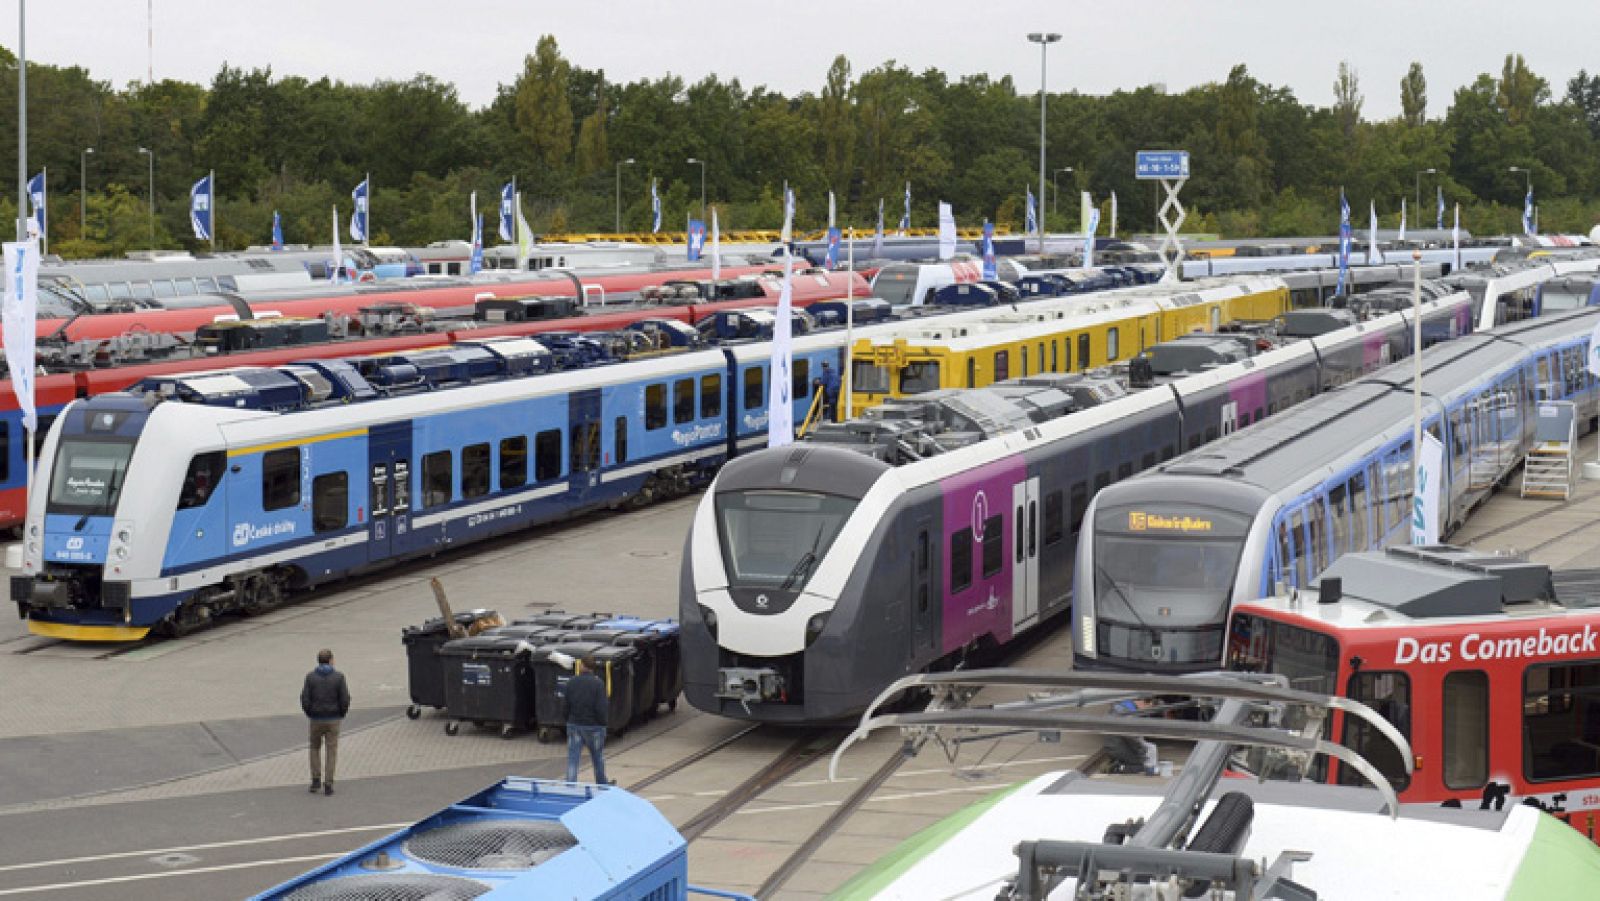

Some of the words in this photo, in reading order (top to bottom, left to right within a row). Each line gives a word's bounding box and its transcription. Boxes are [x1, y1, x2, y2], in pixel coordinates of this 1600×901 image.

[1394, 636, 1452, 664] Das
[1459, 624, 1599, 661] Comeback
[1582, 794, 1600, 806] sta
